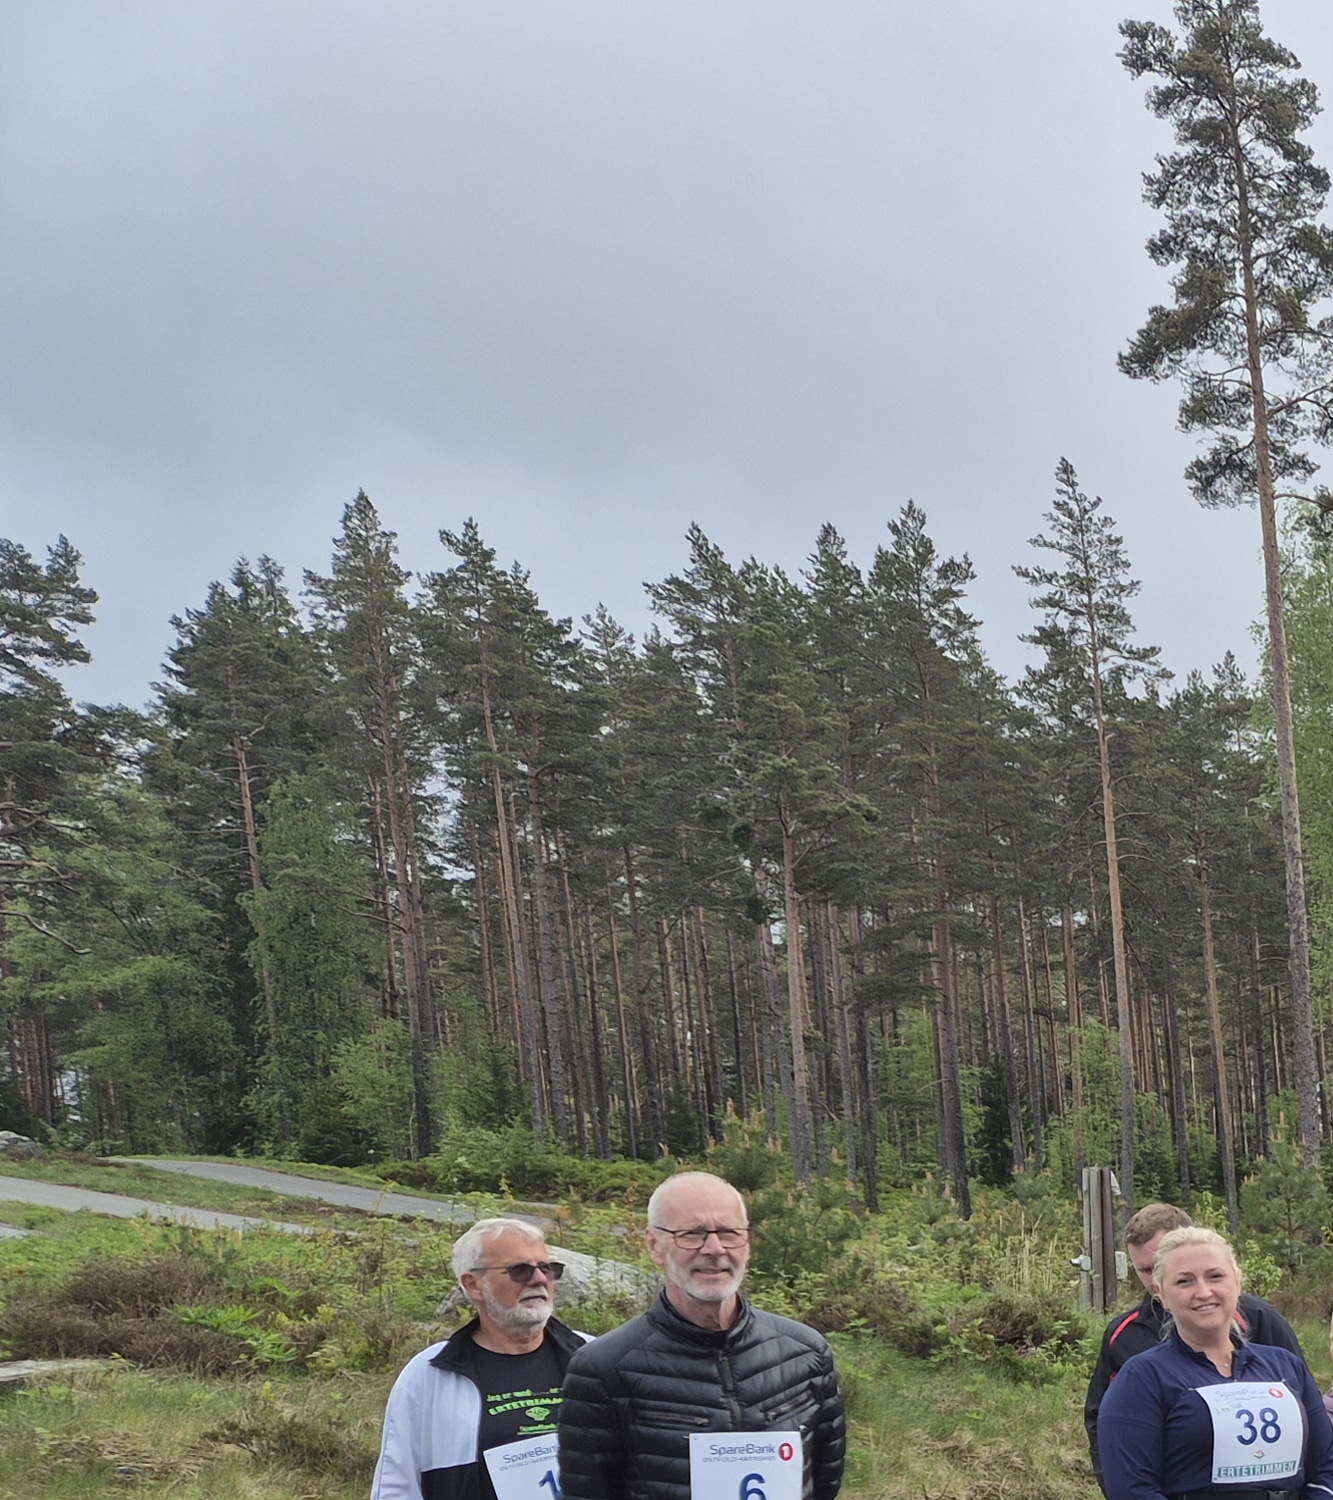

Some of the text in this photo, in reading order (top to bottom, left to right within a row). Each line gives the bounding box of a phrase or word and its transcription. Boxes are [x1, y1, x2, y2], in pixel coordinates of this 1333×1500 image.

[1235, 1408, 1281, 1445] 38
[709, 1443, 775, 1456] SpareBank
[1220, 1461, 1295, 1477] ERTETRIMMEN
